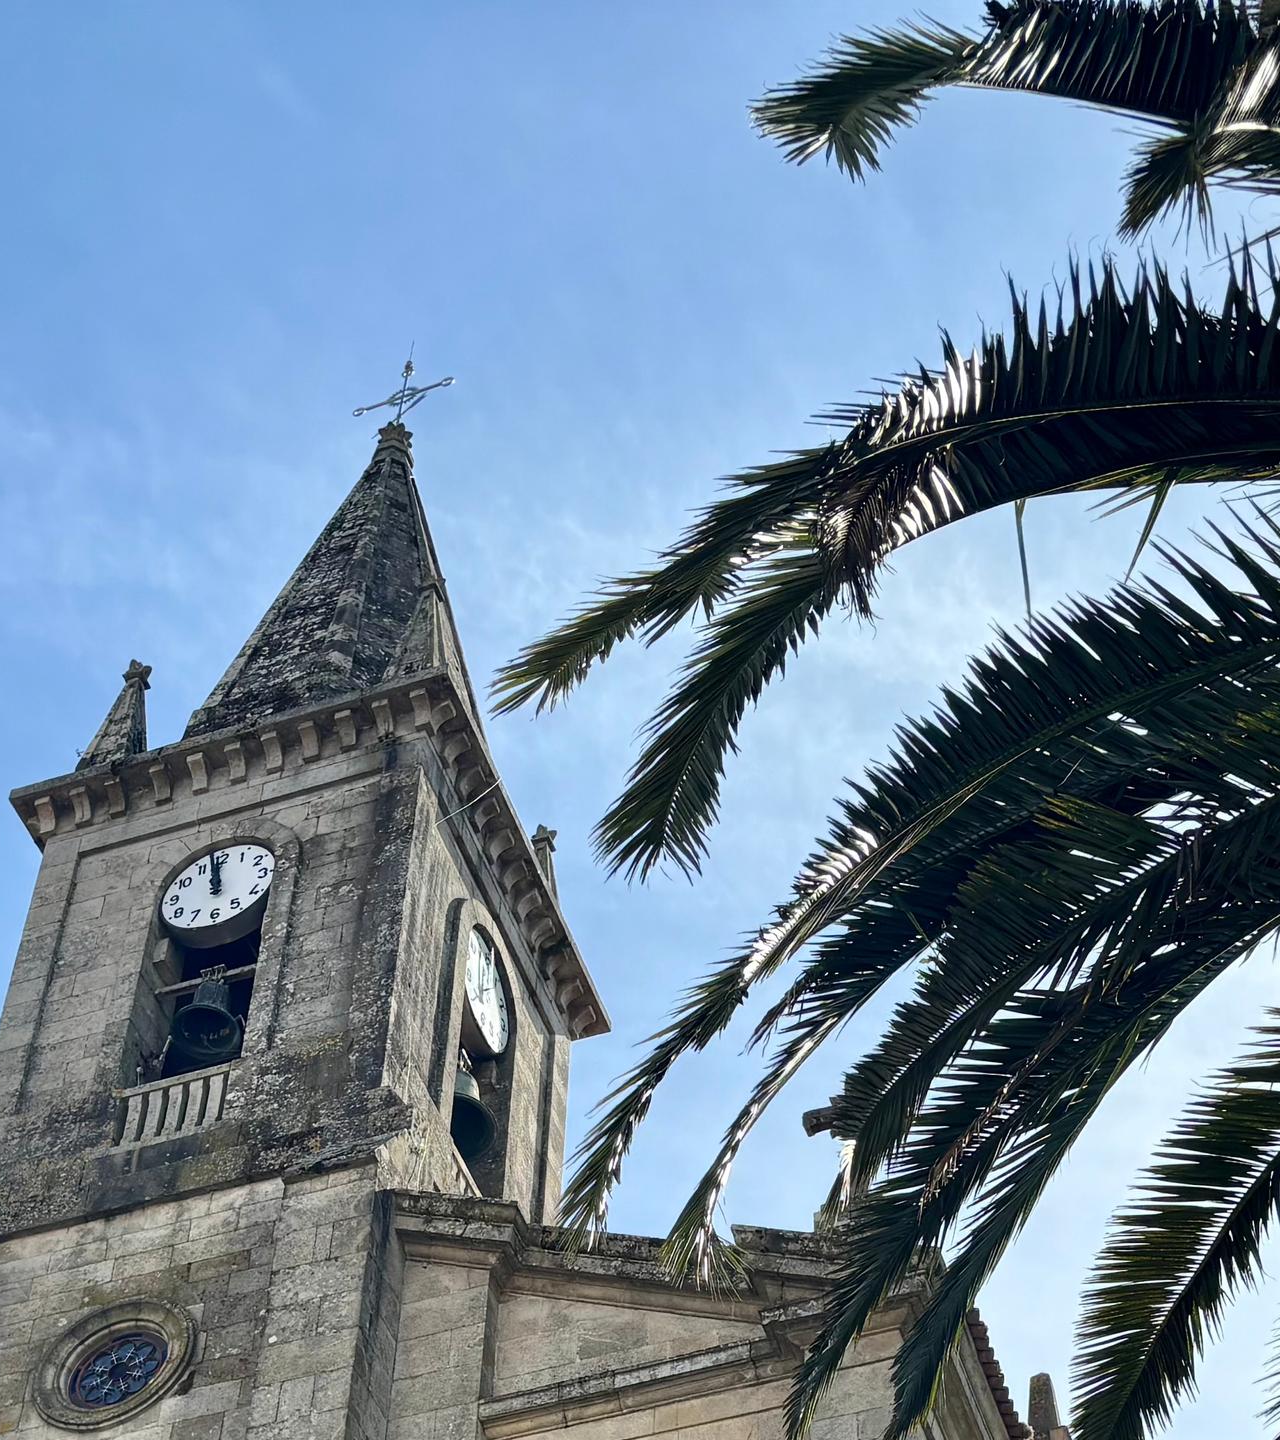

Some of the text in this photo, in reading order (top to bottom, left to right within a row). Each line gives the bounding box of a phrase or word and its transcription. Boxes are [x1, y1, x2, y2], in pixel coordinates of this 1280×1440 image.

[216, 853, 229, 865] 12
[240, 852, 245, 863] 1
[253, 855, 264, 866] 2
[198, 864, 207, 875] 11
[258, 868, 268, 879] 3
[178, 877, 192, 890] 10
[249, 884, 260, 896] 4
[169, 895, 180, 906] 9
[230, 898, 241, 909] 5
[174, 907, 184, 918] 8
[190, 909, 201, 923] 7
[210, 908, 220, 919] 6
